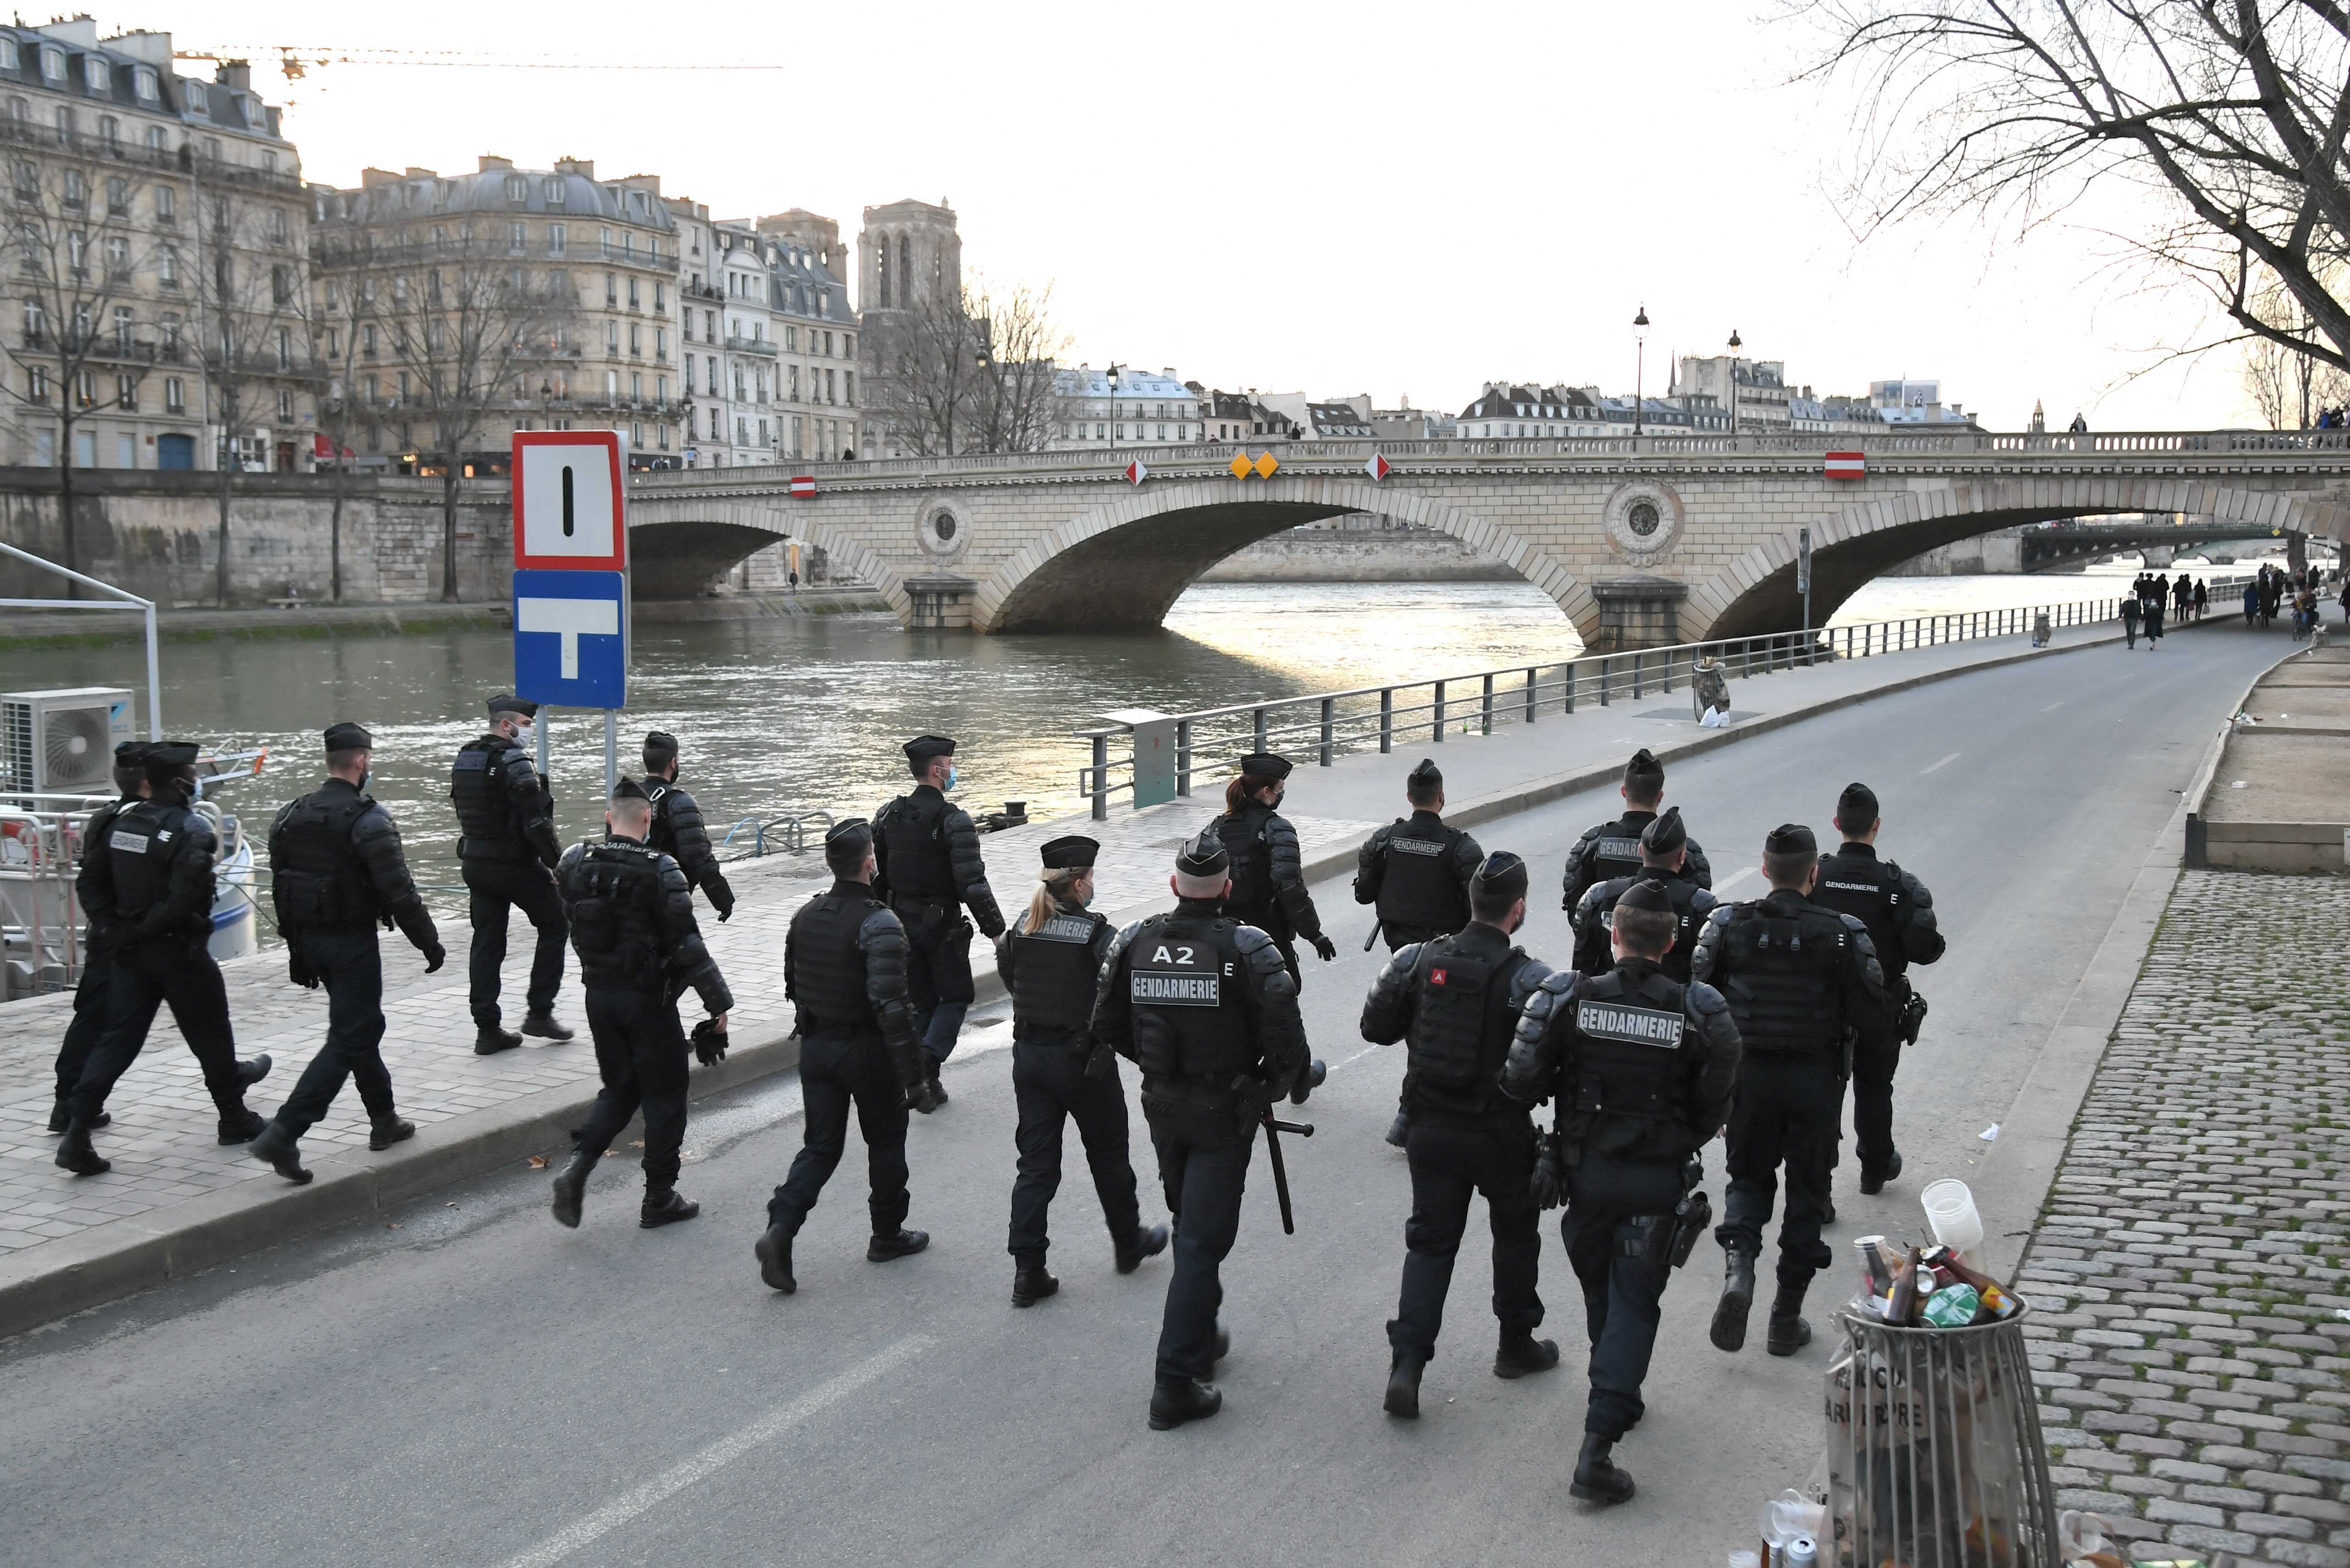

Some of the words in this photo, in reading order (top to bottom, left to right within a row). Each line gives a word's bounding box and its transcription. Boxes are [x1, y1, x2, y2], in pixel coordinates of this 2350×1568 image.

[1393, 839, 1443, 855] GENDARMERIE
[1825, 880, 1879, 892] GENDARMERIE
[1891, 894, 1898, 904] E
[1018, 917, 1091, 939] GARMERIE
[1681, 916, 1689, 927] E
[1152, 946, 1194, 964] A2
[1224, 962, 1234, 976] E
[1434, 972, 1443, 981] A
[1133, 977, 1217, 999] GENDARMERIE
[1579, 1007, 1681, 1042] GENDARMERIE
